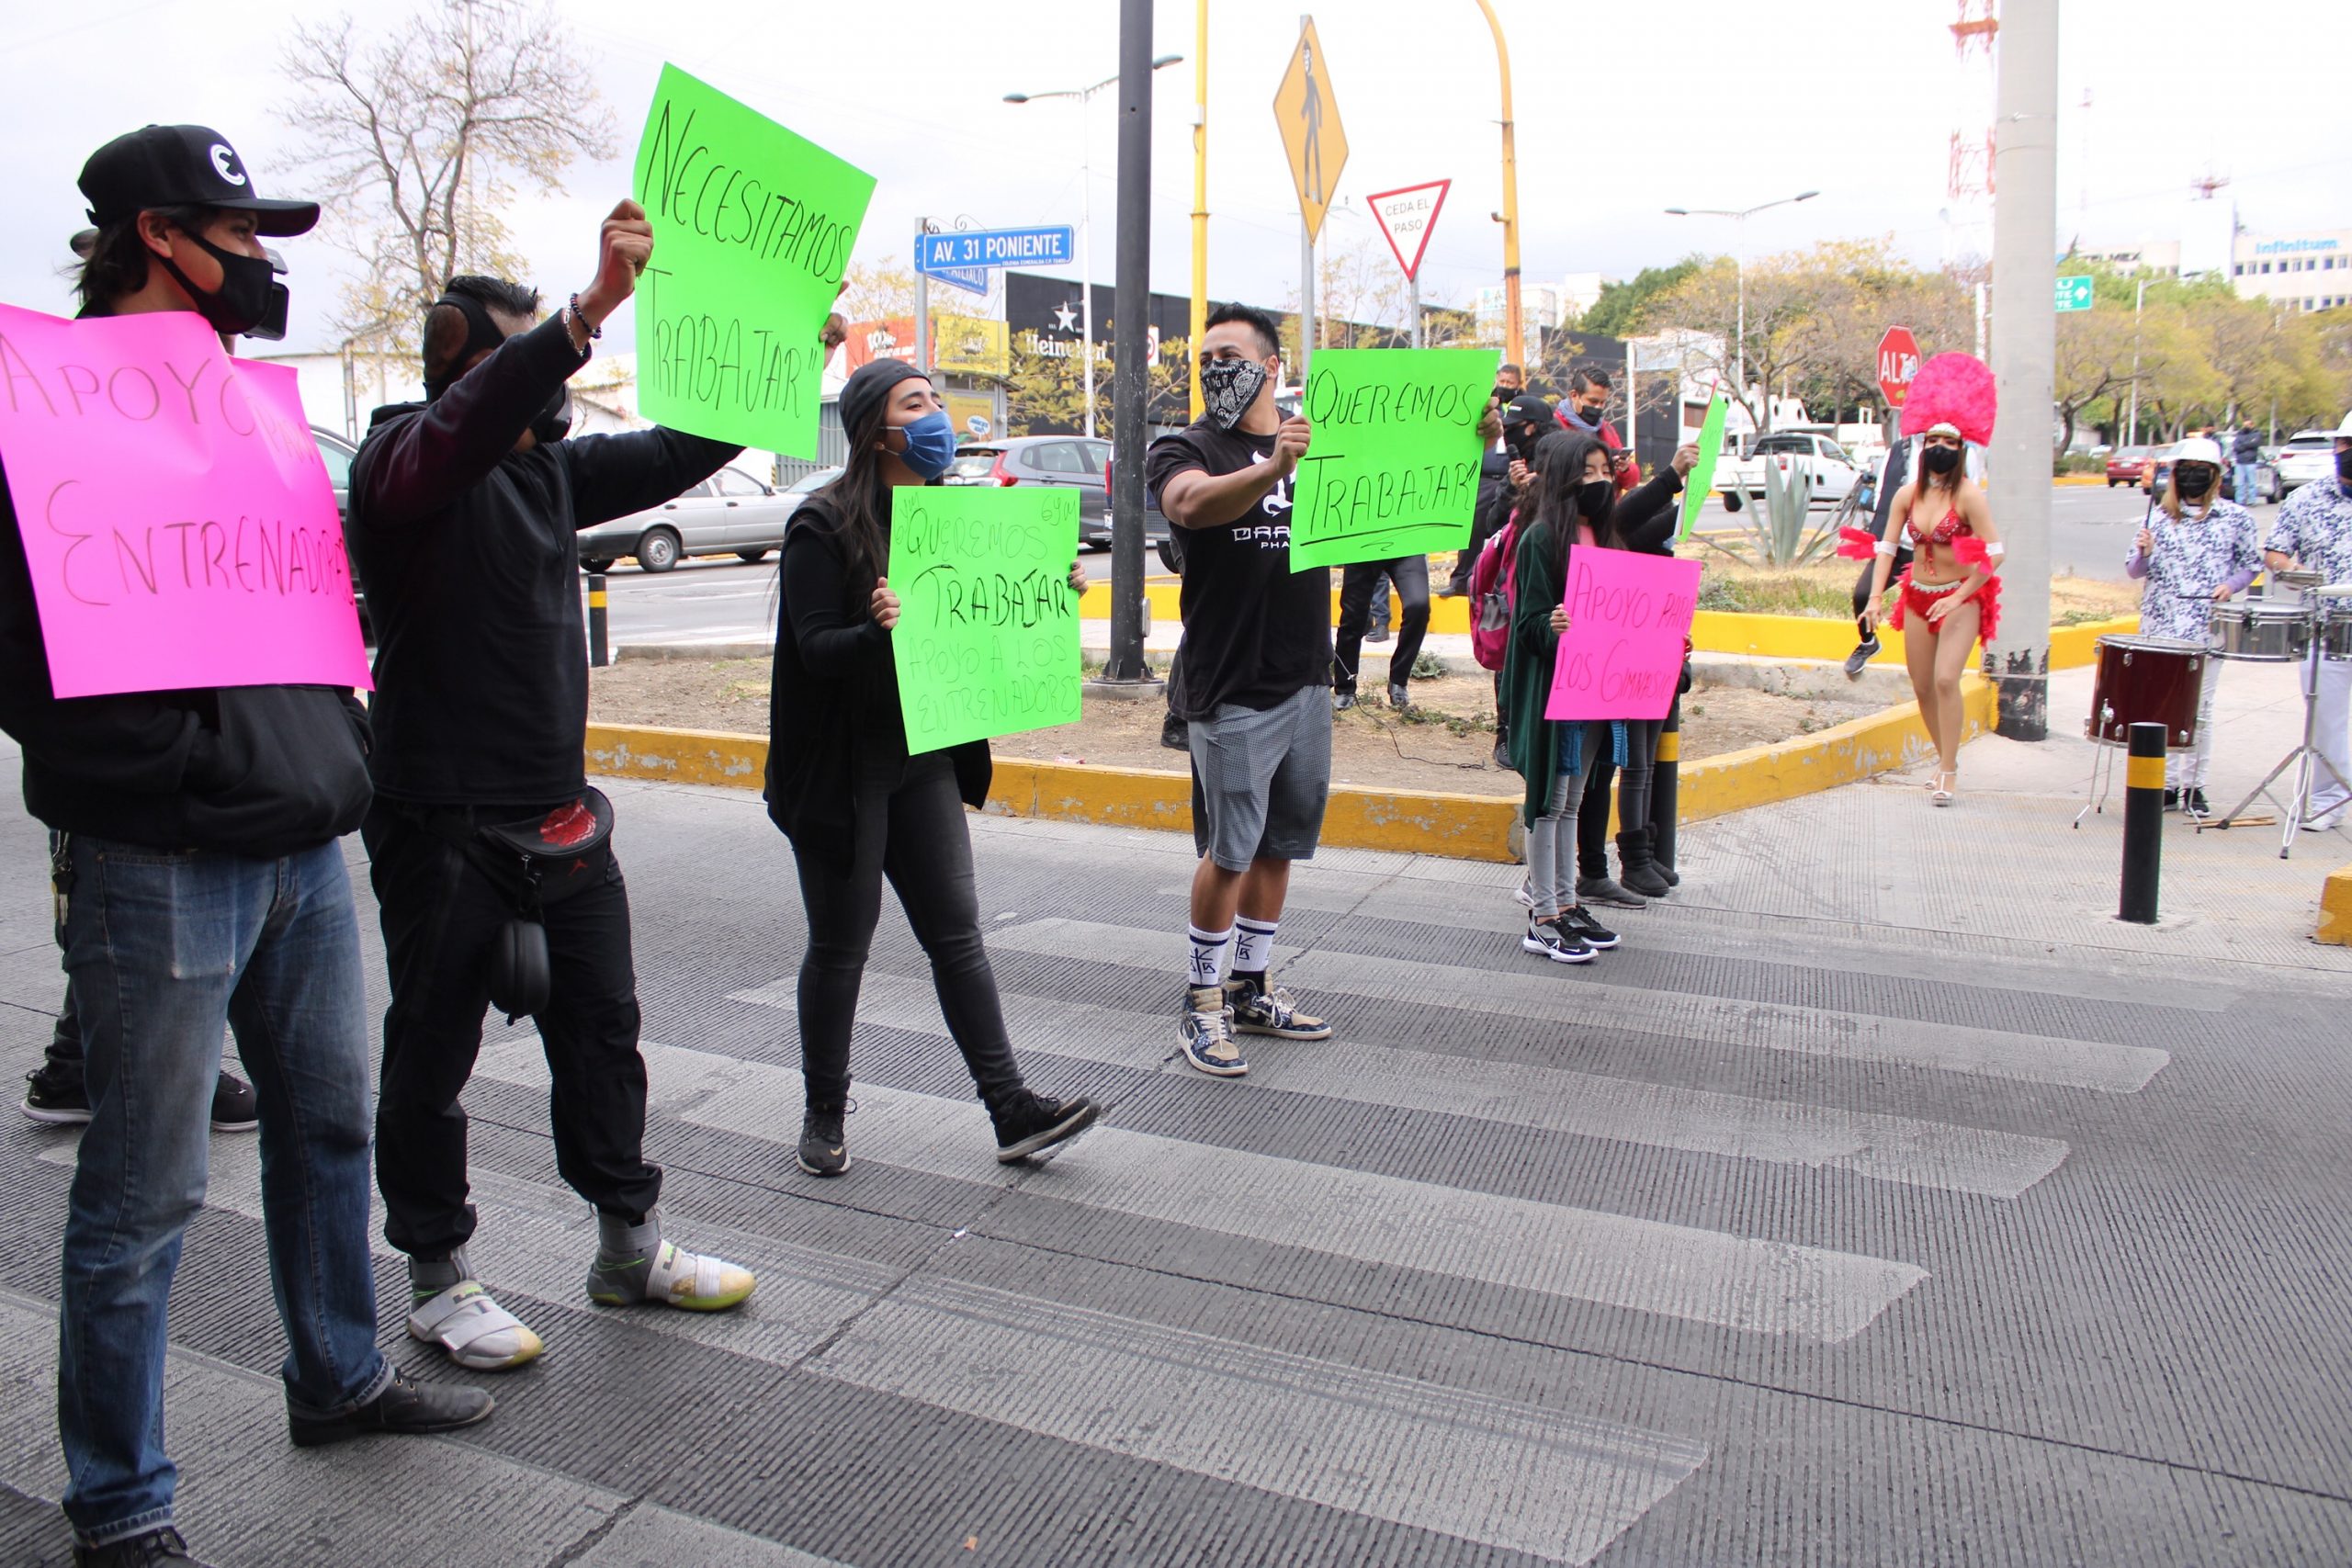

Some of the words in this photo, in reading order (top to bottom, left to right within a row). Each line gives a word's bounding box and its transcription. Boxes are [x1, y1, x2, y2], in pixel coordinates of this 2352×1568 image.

[642, 99, 852, 284] NECESITAMOS
[1385, 202, 1415, 217] CEDA
[1418, 198, 1430, 211] EL
[933, 241, 956, 263] AV.
[963, 239, 979, 260] 31
[986, 233, 1062, 259] PONIENTE
[1394, 219, 1423, 234] PASO
[1025, 333, 1106, 360] Heinekn
[1880, 350, 1918, 384] ALTO
[0, 333, 256, 436] APOYO
[907, 507, 1048, 561] QUEREMOS
[910, 564, 1070, 628] TRABAJAR
[1572, 562, 1651, 628] APOYO
[909, 637, 980, 683] APOYO
[990, 635, 1003, 673] A
[1016, 635, 1068, 669] LOS
[1555, 646, 1592, 692] LOS
[918, 674, 1080, 733] ENTRENADORES
